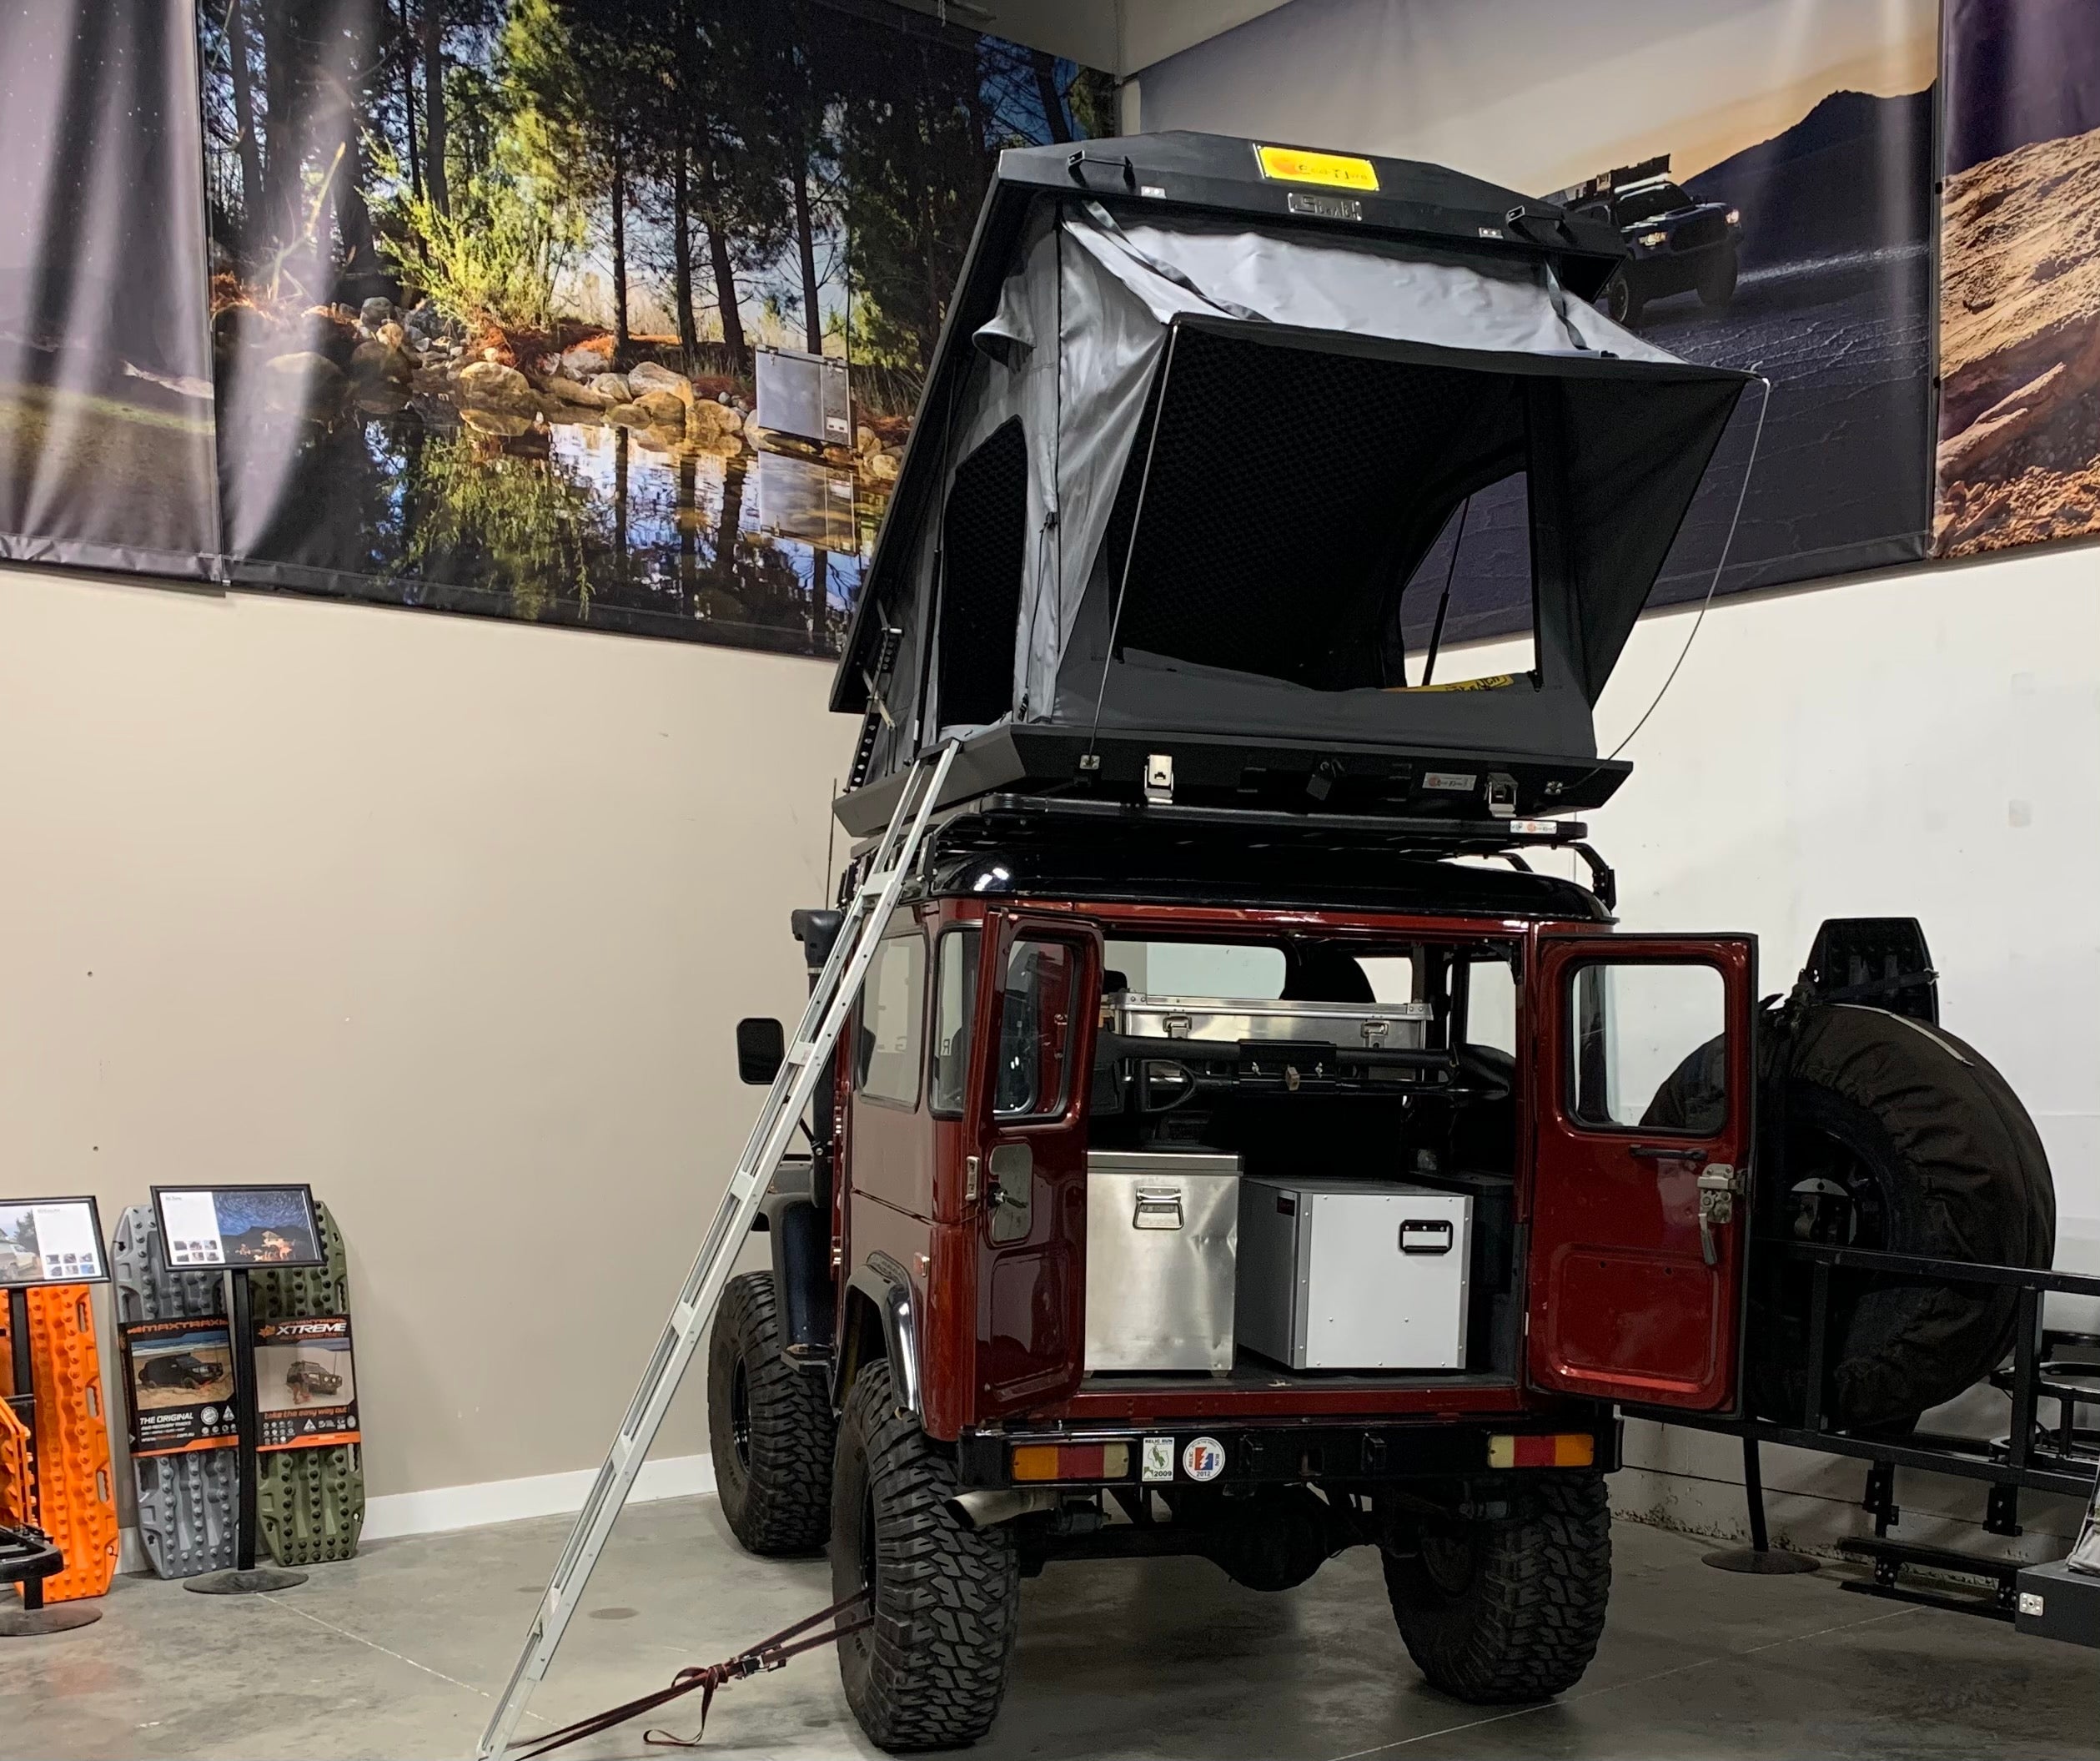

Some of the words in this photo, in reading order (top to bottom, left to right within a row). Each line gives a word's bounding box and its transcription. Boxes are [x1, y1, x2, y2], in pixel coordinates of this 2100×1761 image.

[275, 1322, 347, 1336] XTREME
[140, 1416, 156, 1425] THE
[156, 1412, 194, 1423] ORIGINAL
[299, 1409, 317, 1417] easy
